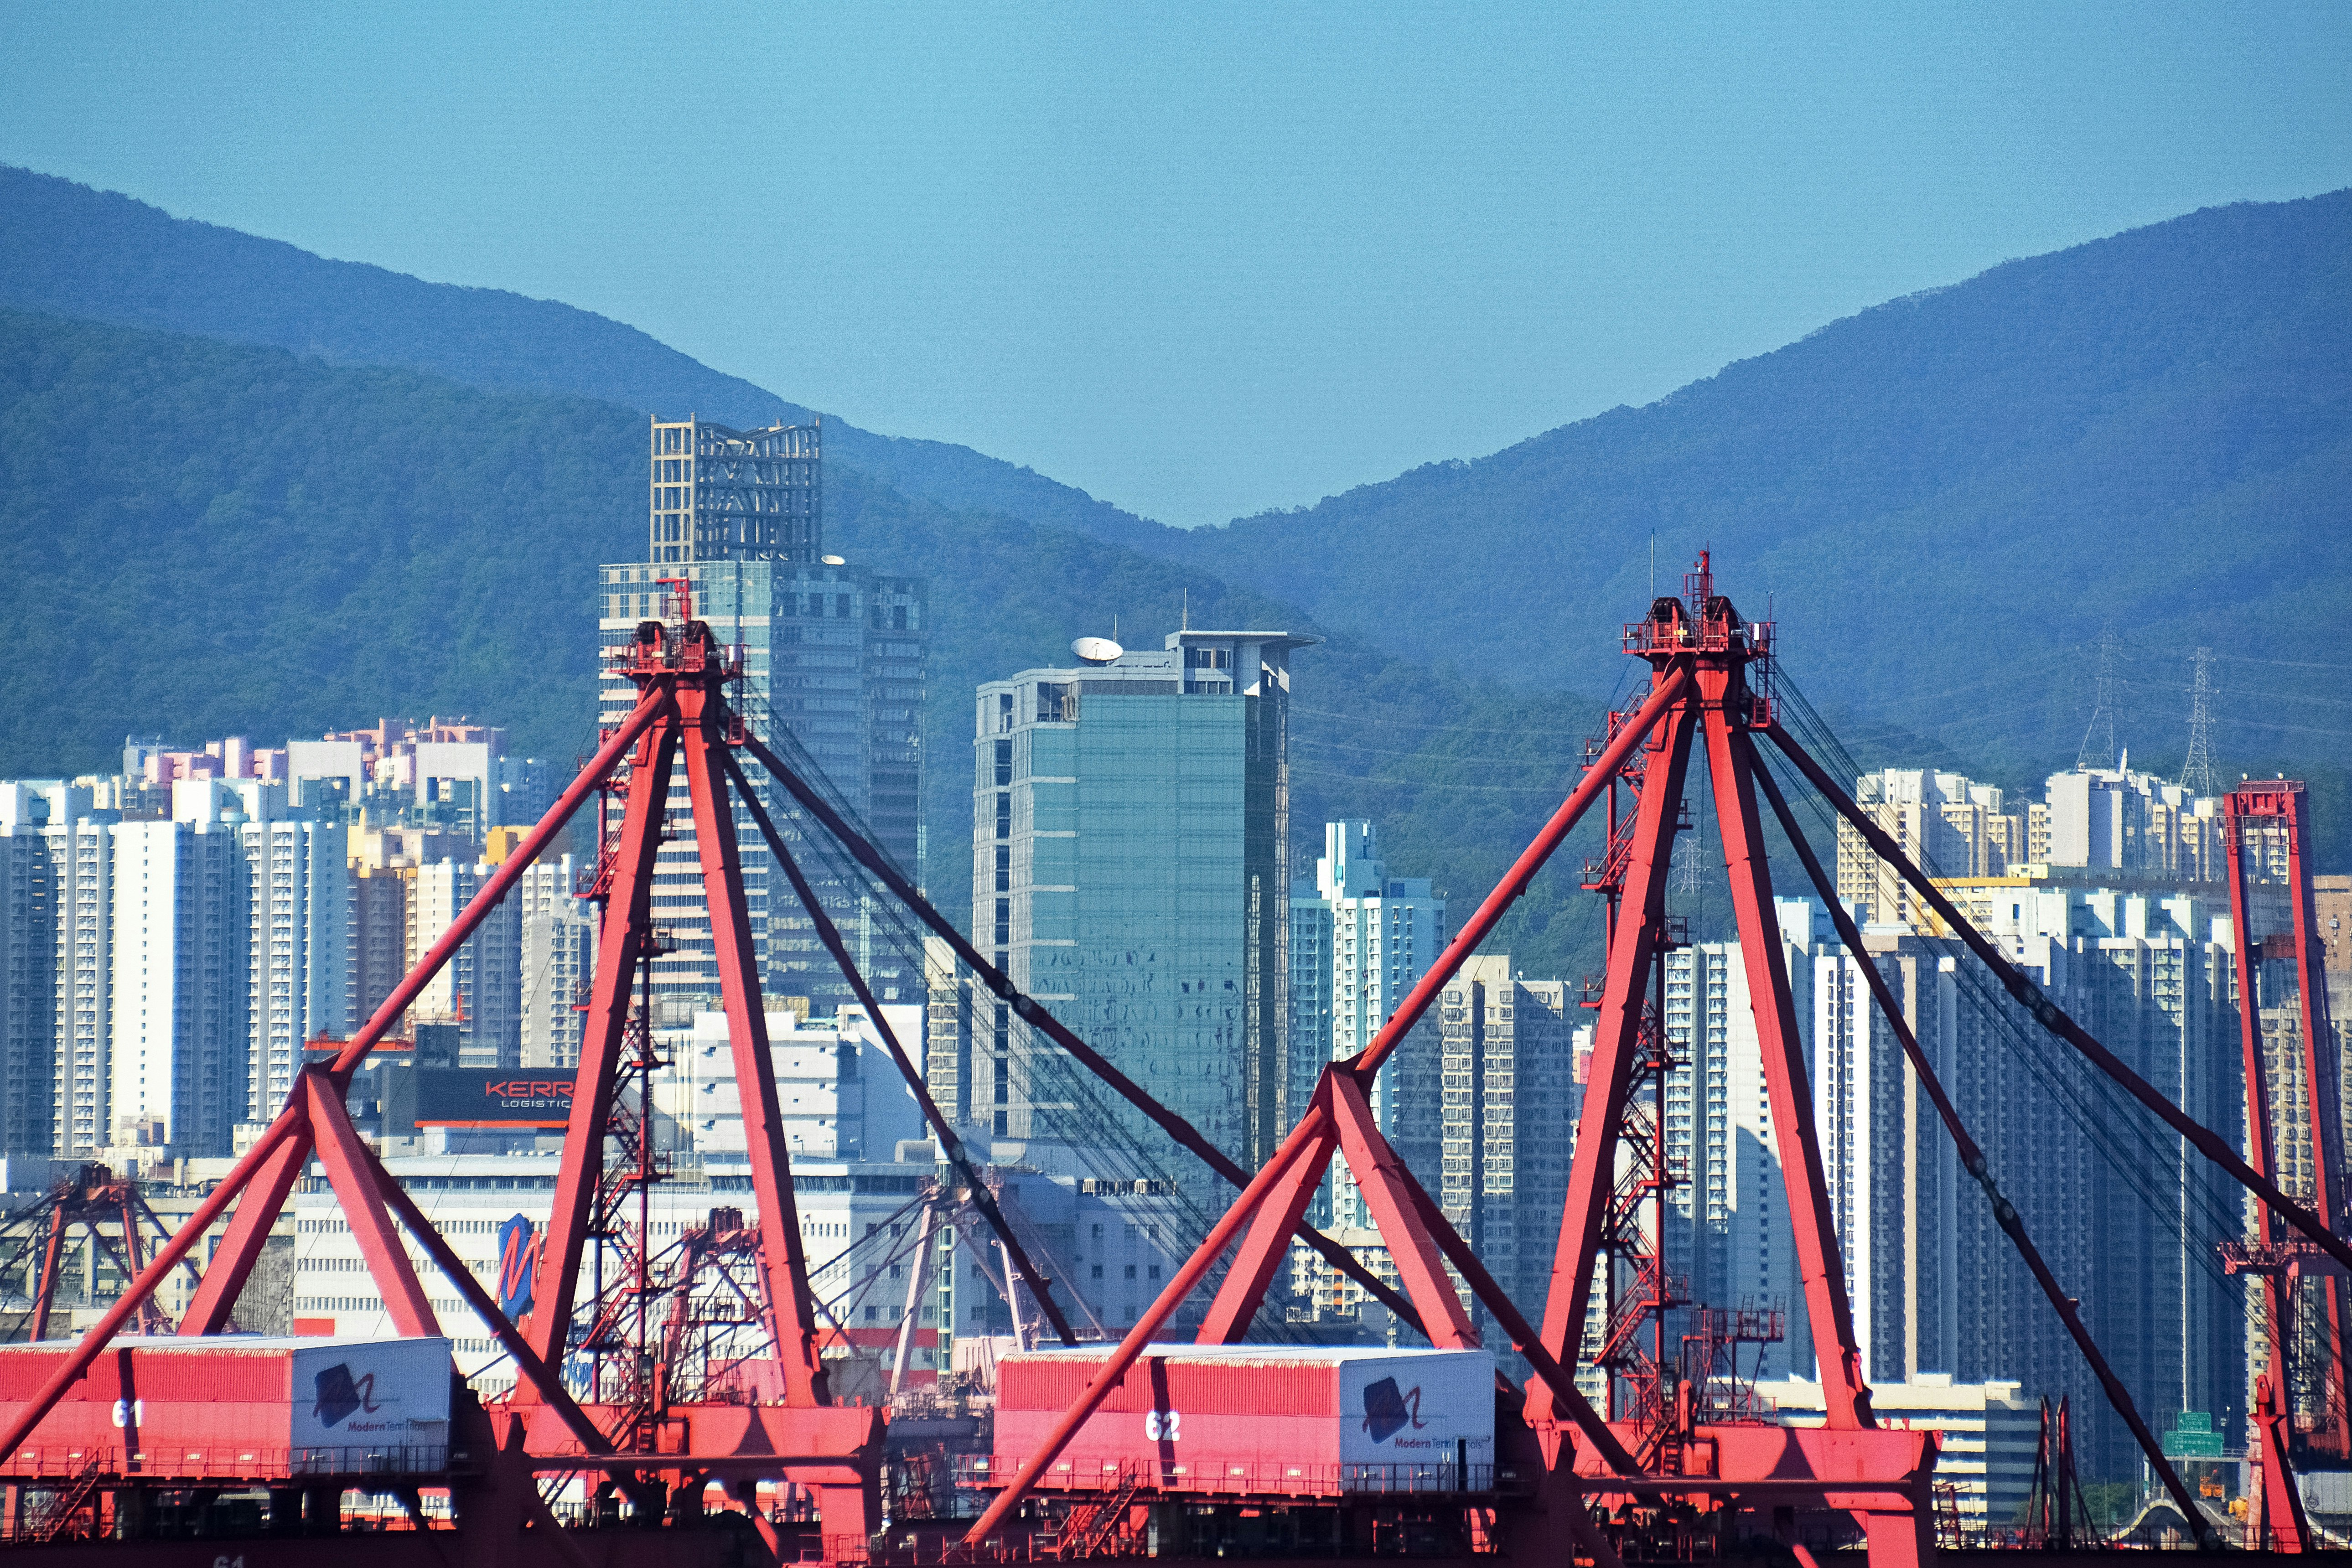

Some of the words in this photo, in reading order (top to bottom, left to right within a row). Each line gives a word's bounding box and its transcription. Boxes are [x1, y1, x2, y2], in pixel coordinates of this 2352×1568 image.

[486, 1081, 575, 1097] KERR
[501, 1100, 572, 1108] LOGISTIC
[112, 1399, 142, 1428] 61
[348, 1422, 385, 1432] Modern
[1145, 1411, 1180, 1441] 62
[1395, 1437, 1431, 1449] Modern
